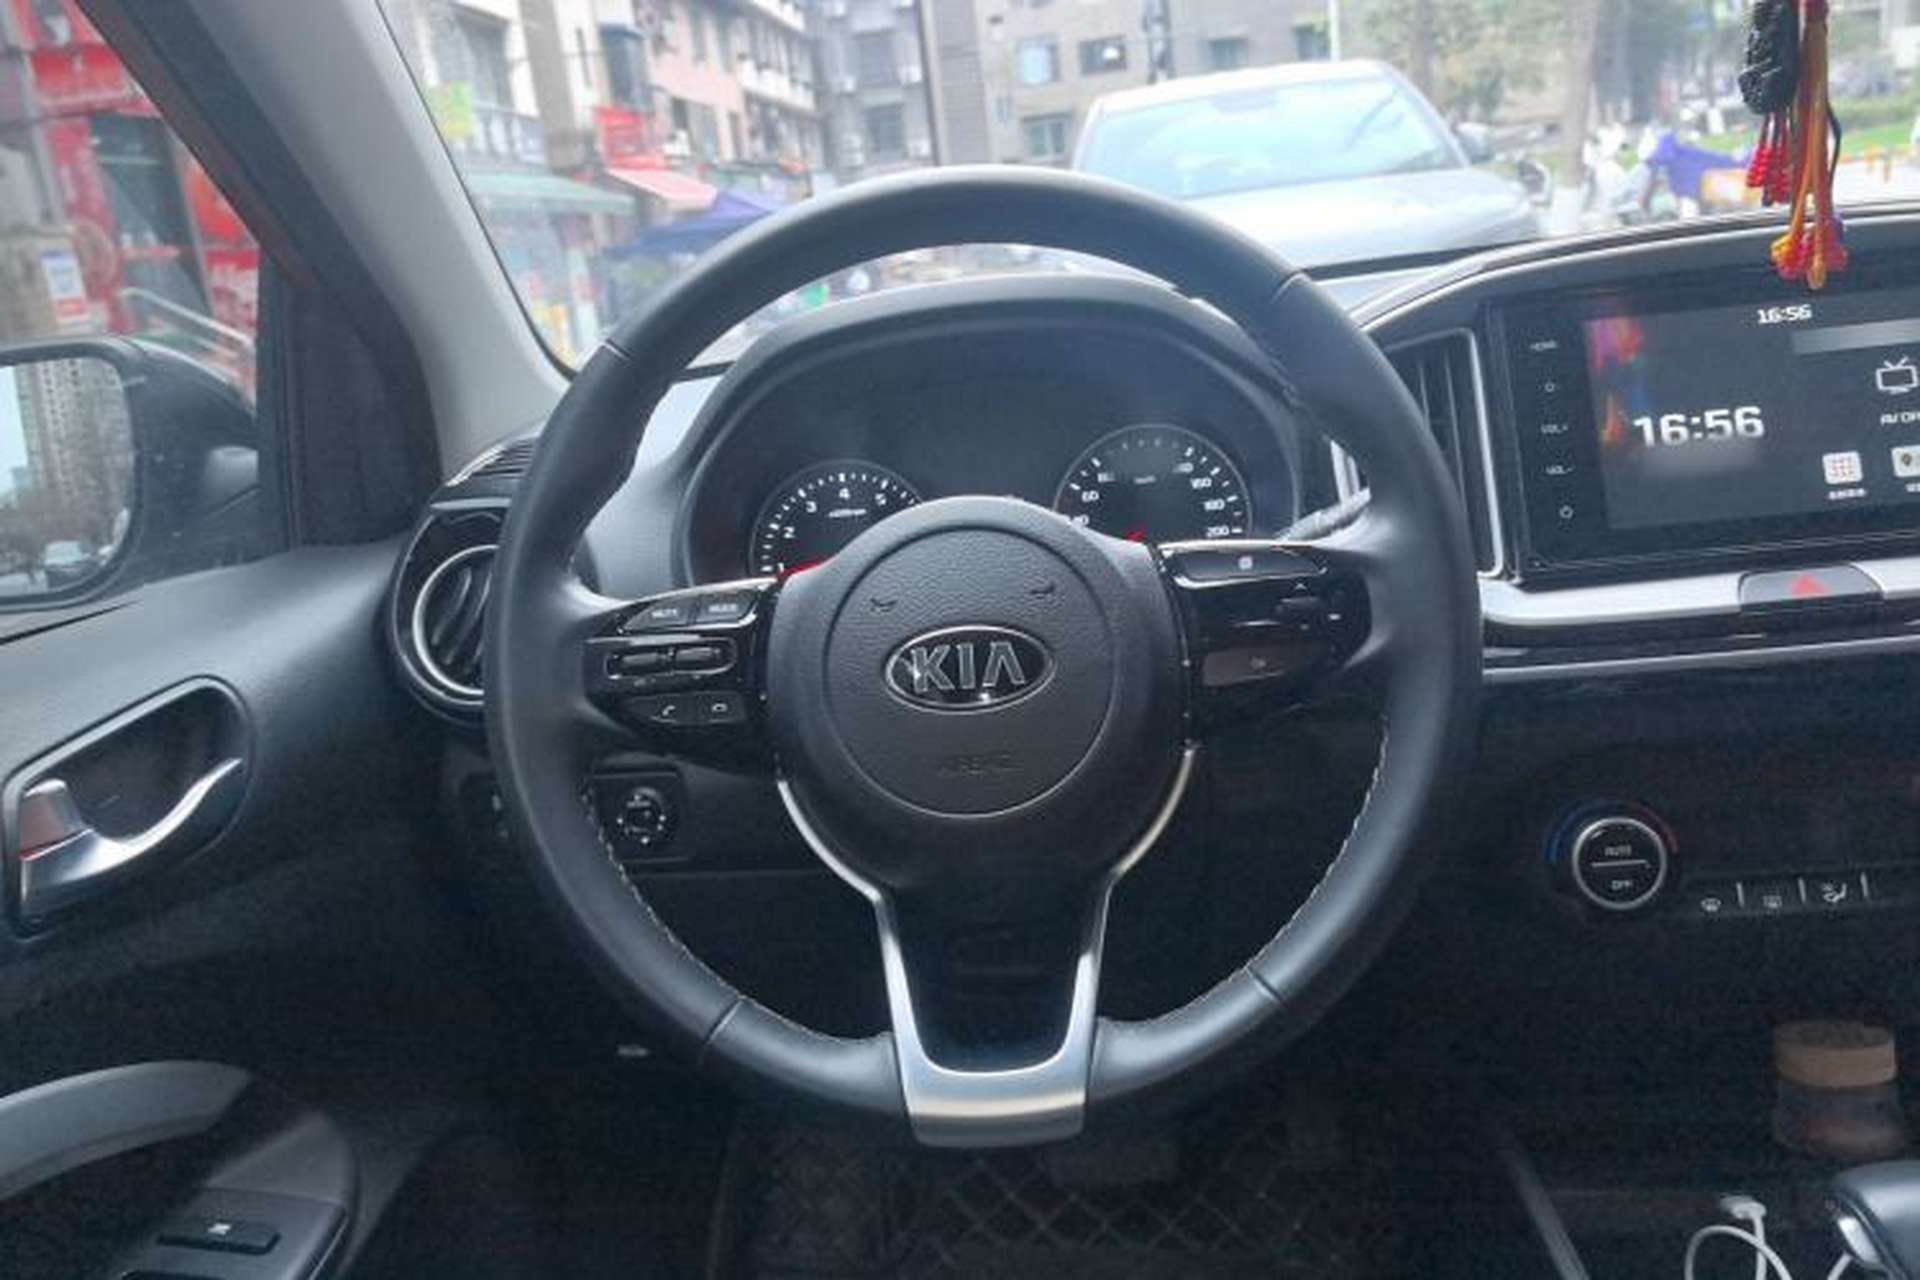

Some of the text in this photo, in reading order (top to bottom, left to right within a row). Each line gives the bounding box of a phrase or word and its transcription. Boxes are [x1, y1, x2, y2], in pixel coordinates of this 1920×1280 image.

[1757, 304, 1813, 325] 16:56
[1633, 405, 1765, 449] 16:56
[909, 640, 1027, 694] KIA
